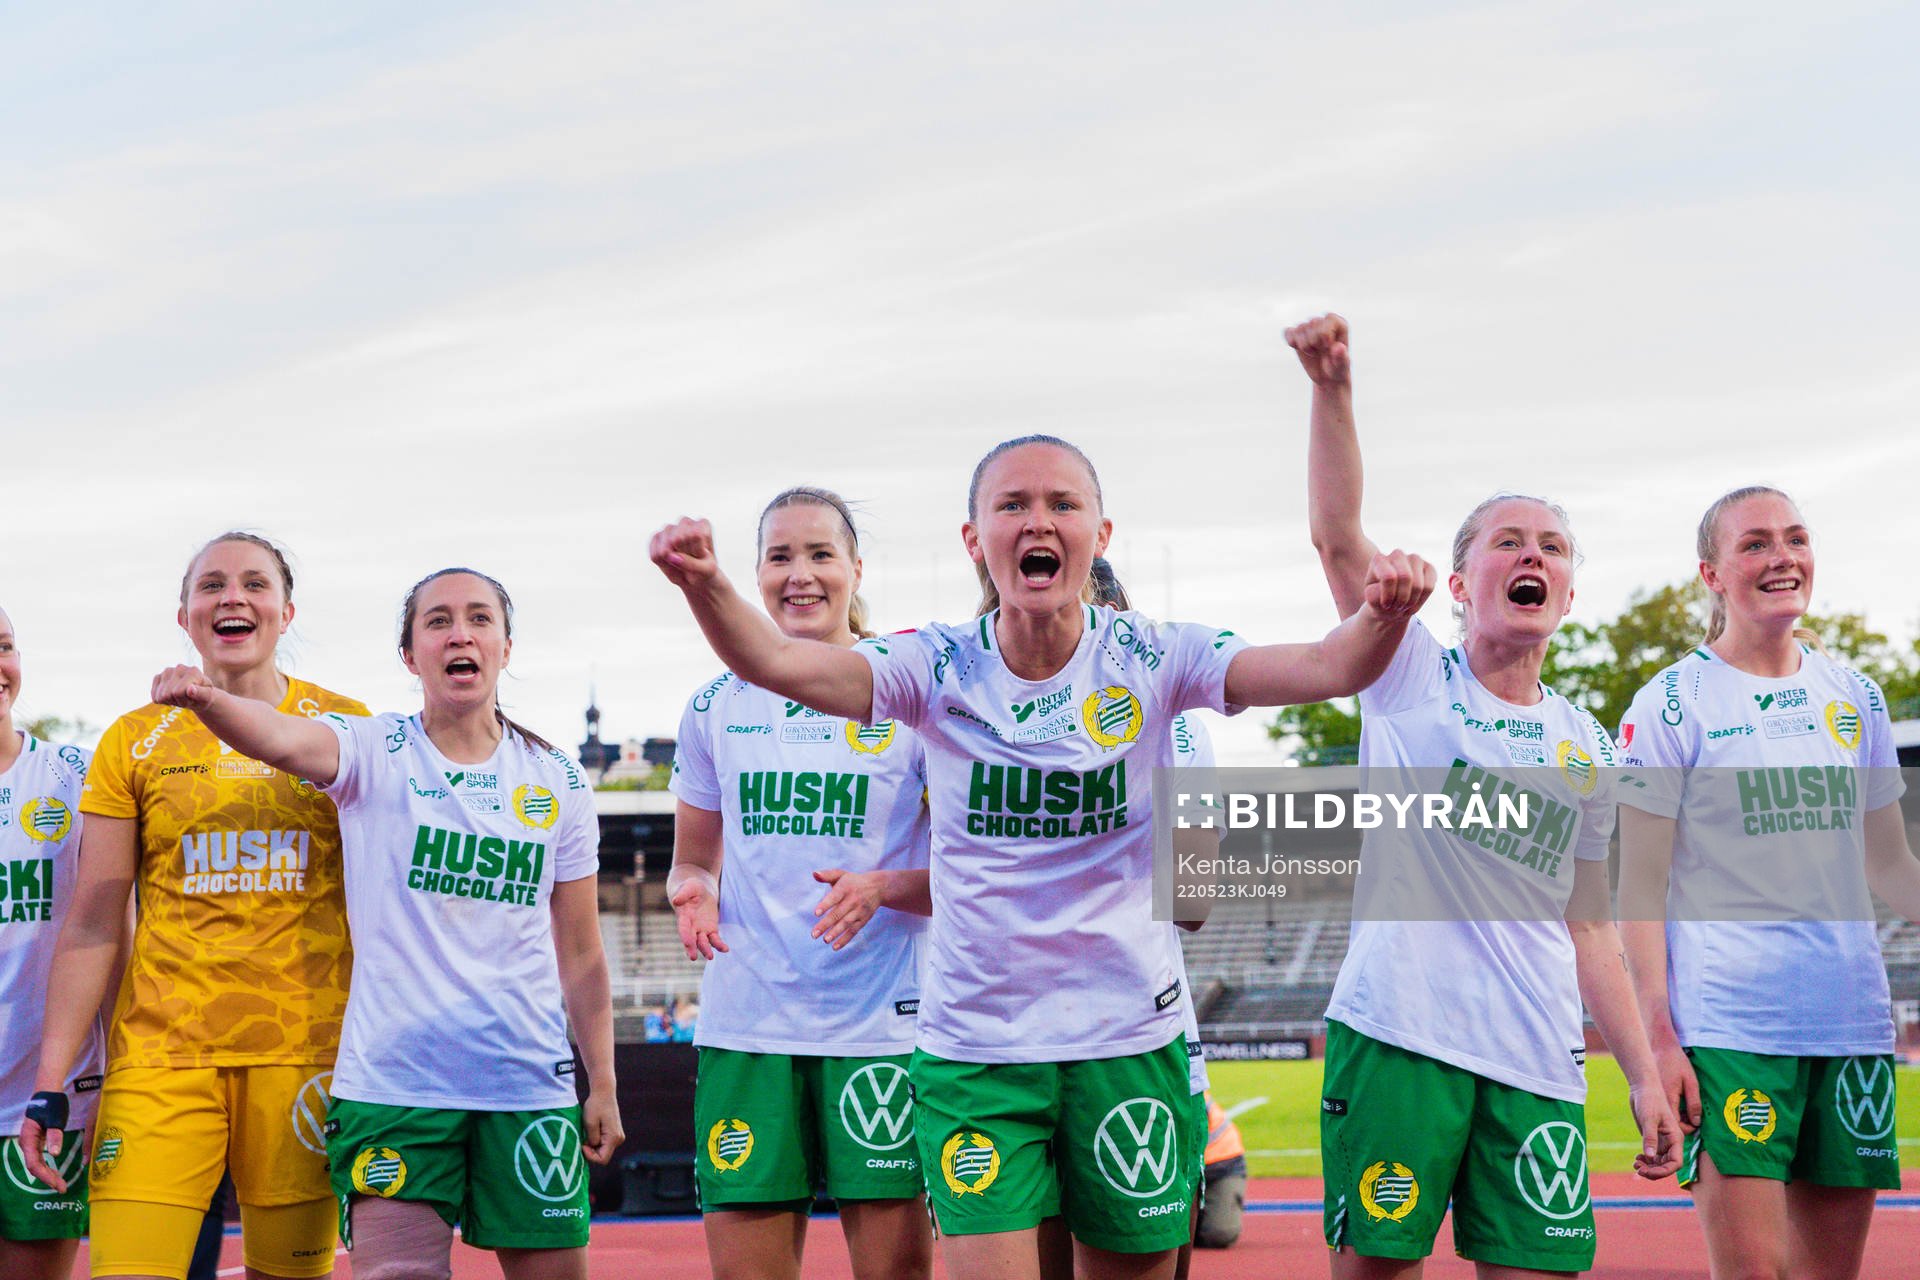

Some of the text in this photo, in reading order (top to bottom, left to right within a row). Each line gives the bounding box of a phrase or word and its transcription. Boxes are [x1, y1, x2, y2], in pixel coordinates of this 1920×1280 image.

[1037, 684, 1071, 707] INTER
[1774, 688, 1807, 701] INTER
[1039, 693, 1072, 717] SPORT
[1777, 697, 1808, 709] SPORT
[947, 706, 991, 729] CRAFT
[1507, 718, 1543, 732] INTER
[726, 725, 763, 734] CRAFT
[1508, 728, 1543, 741] SPORT
[1707, 726, 1745, 739] CRAFT
[160, 765, 199, 776] CRAFT
[466, 771, 497, 781] INTER
[466, 780, 497, 789] SPORT
[968, 759, 1127, 815] HUSKI
[1736, 765, 1857, 813] HUSKI
[739, 771, 869, 816] HUSKI
[742, 814, 864, 838] CHOCOLATE
[967, 805, 1127, 838] CHOCOLATE
[1743, 810, 1855, 836] CHOCOLAT
[182, 830, 310, 874] HUSKI
[411, 825, 545, 884] HUSKI
[183, 871, 305, 894] CHOCOLATE
[408, 869, 538, 906] CHOCOLATE
[1856, 1147, 1892, 1158] CRAFT
[866, 1159, 907, 1169] CRAFT
[33, 1201, 74, 1211] CRAFT
[542, 1208, 578, 1219] CRAFT
[1138, 1201, 1179, 1219] CRAFT
[1545, 1226, 1587, 1238] CRAFT
